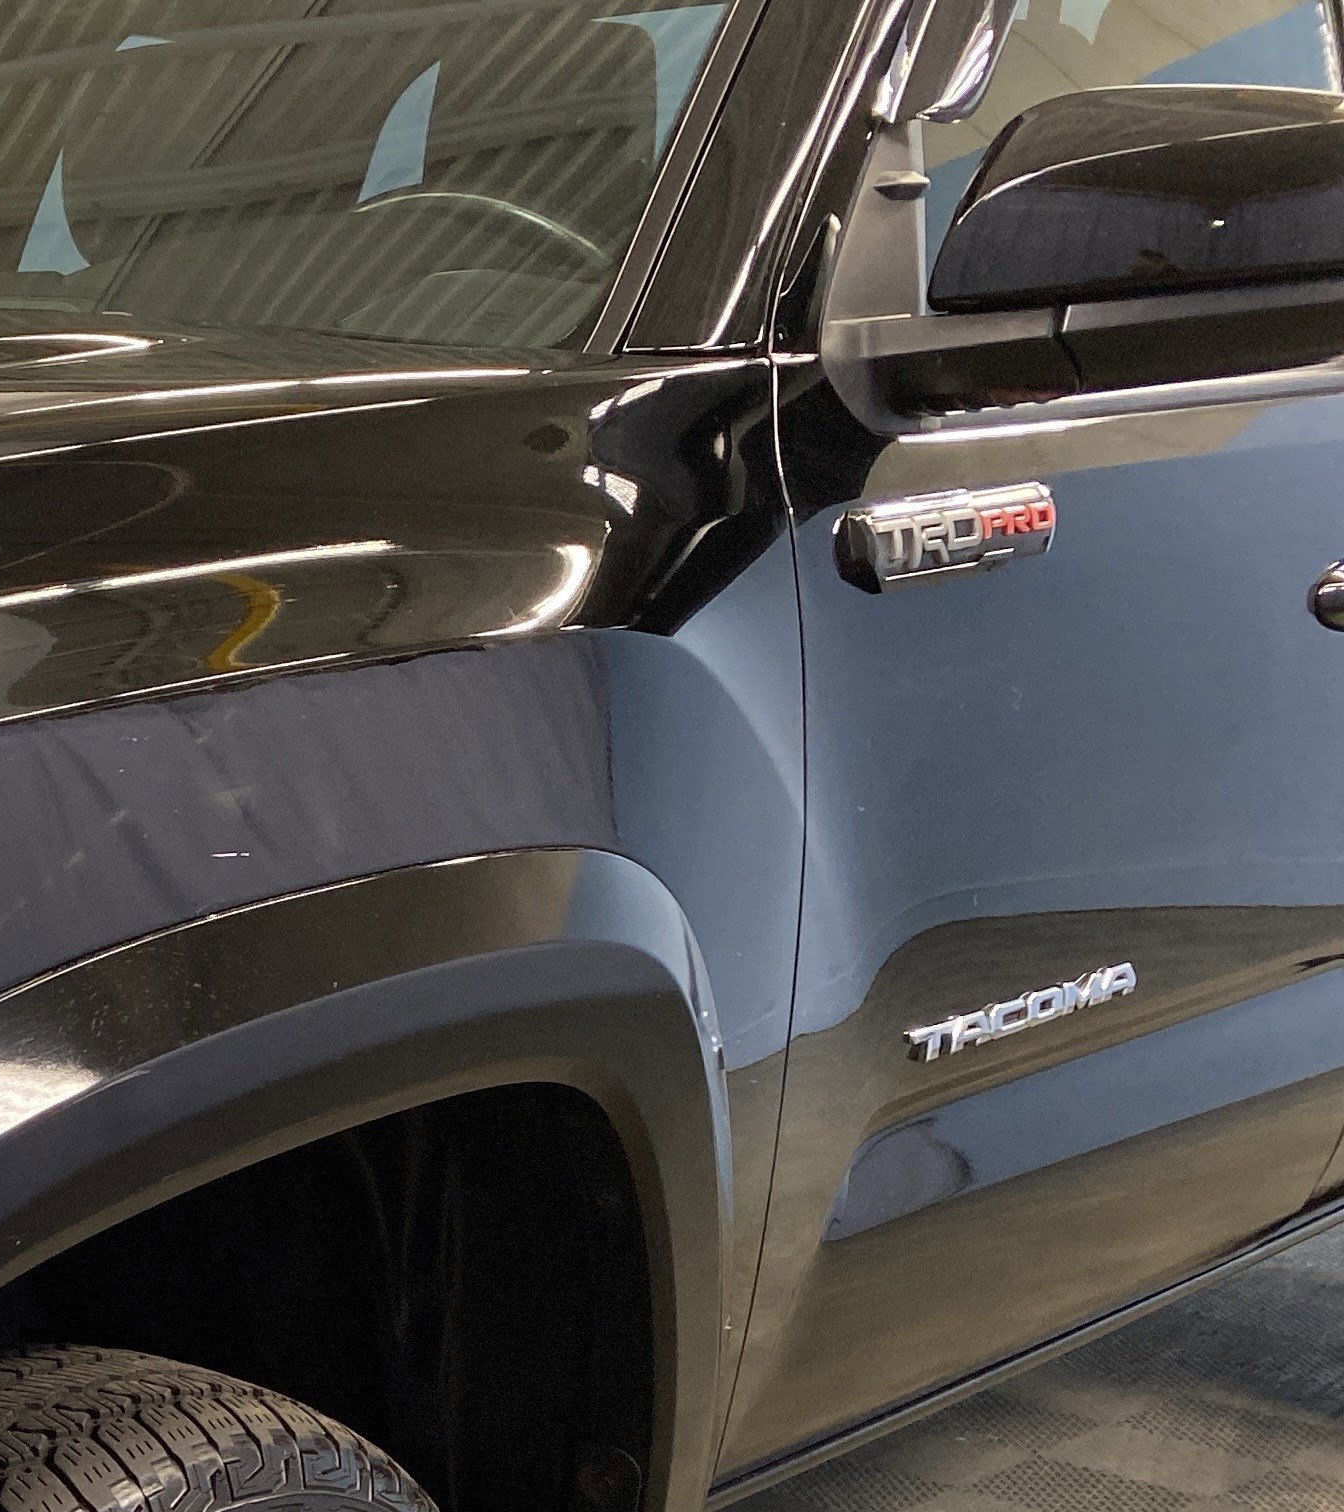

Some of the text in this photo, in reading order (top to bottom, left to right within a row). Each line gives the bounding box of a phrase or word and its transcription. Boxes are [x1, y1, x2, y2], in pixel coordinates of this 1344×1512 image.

[873, 501, 1054, 569] TRD PRO
[903, 961, 1137, 1063] TACOMA
